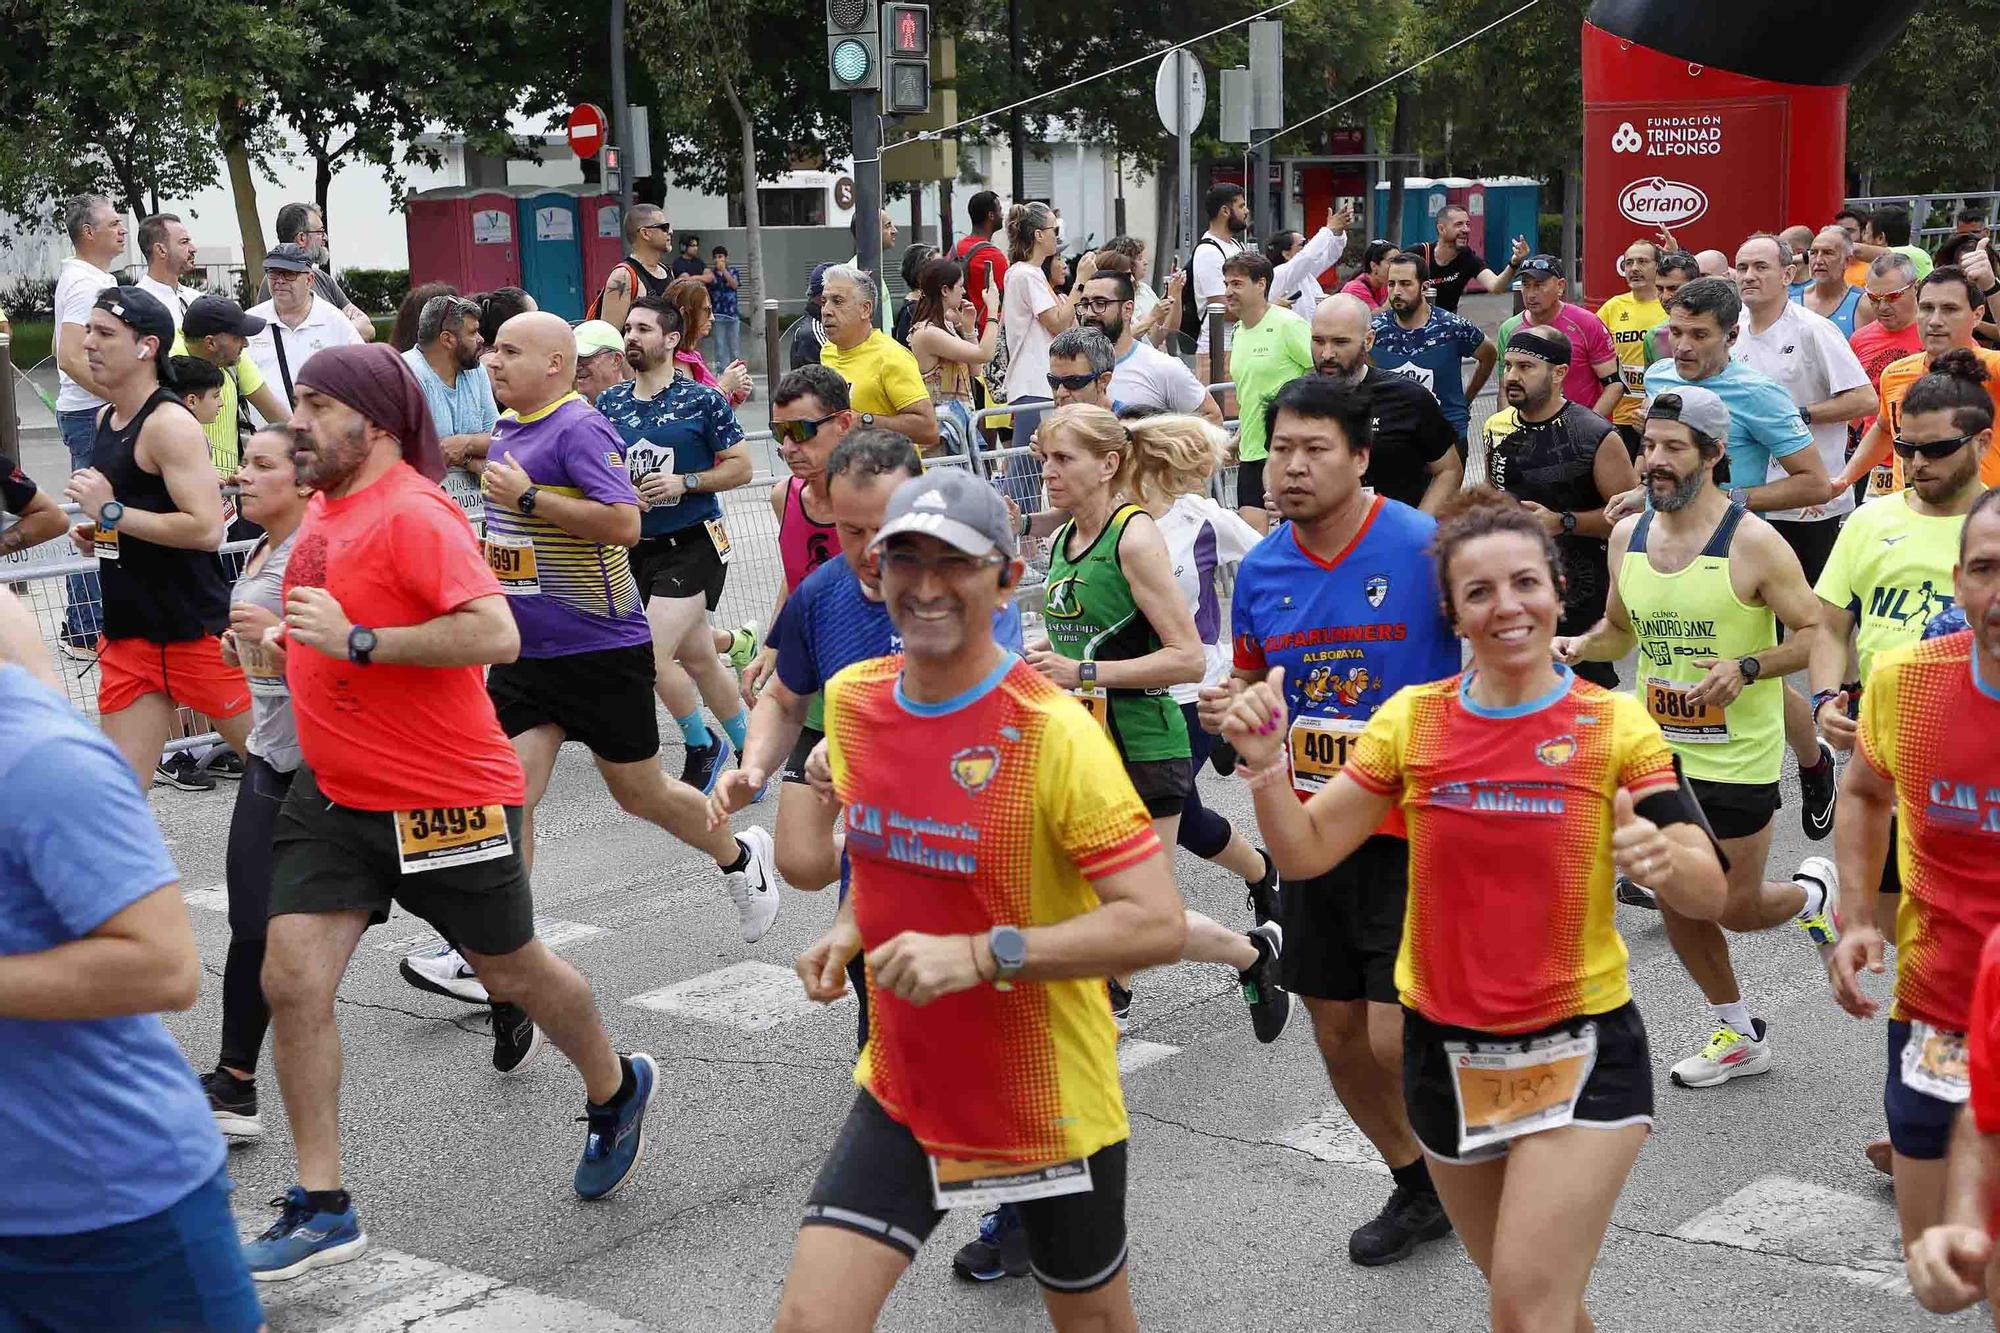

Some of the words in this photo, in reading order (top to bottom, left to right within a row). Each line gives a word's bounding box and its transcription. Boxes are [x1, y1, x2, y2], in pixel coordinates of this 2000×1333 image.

[1648, 115, 1721, 127] FUNDACIÓN
[1647, 128, 1721, 142] TRINIDAD
[1647, 142, 1721, 156] ALFONSO
[1627, 192, 1698, 212] Serrano
[1652, 610, 1679, 618] CLÍNICA
[1684, 621, 1716, 637] SANZ
[1303, 649, 1364, 663] ALBORAYA
[1674, 646, 1718, 656] SOUL
[1472, 791, 1565, 813] Milano
[410, 806, 486, 840] 3493
[888, 832, 977, 873] Milano
